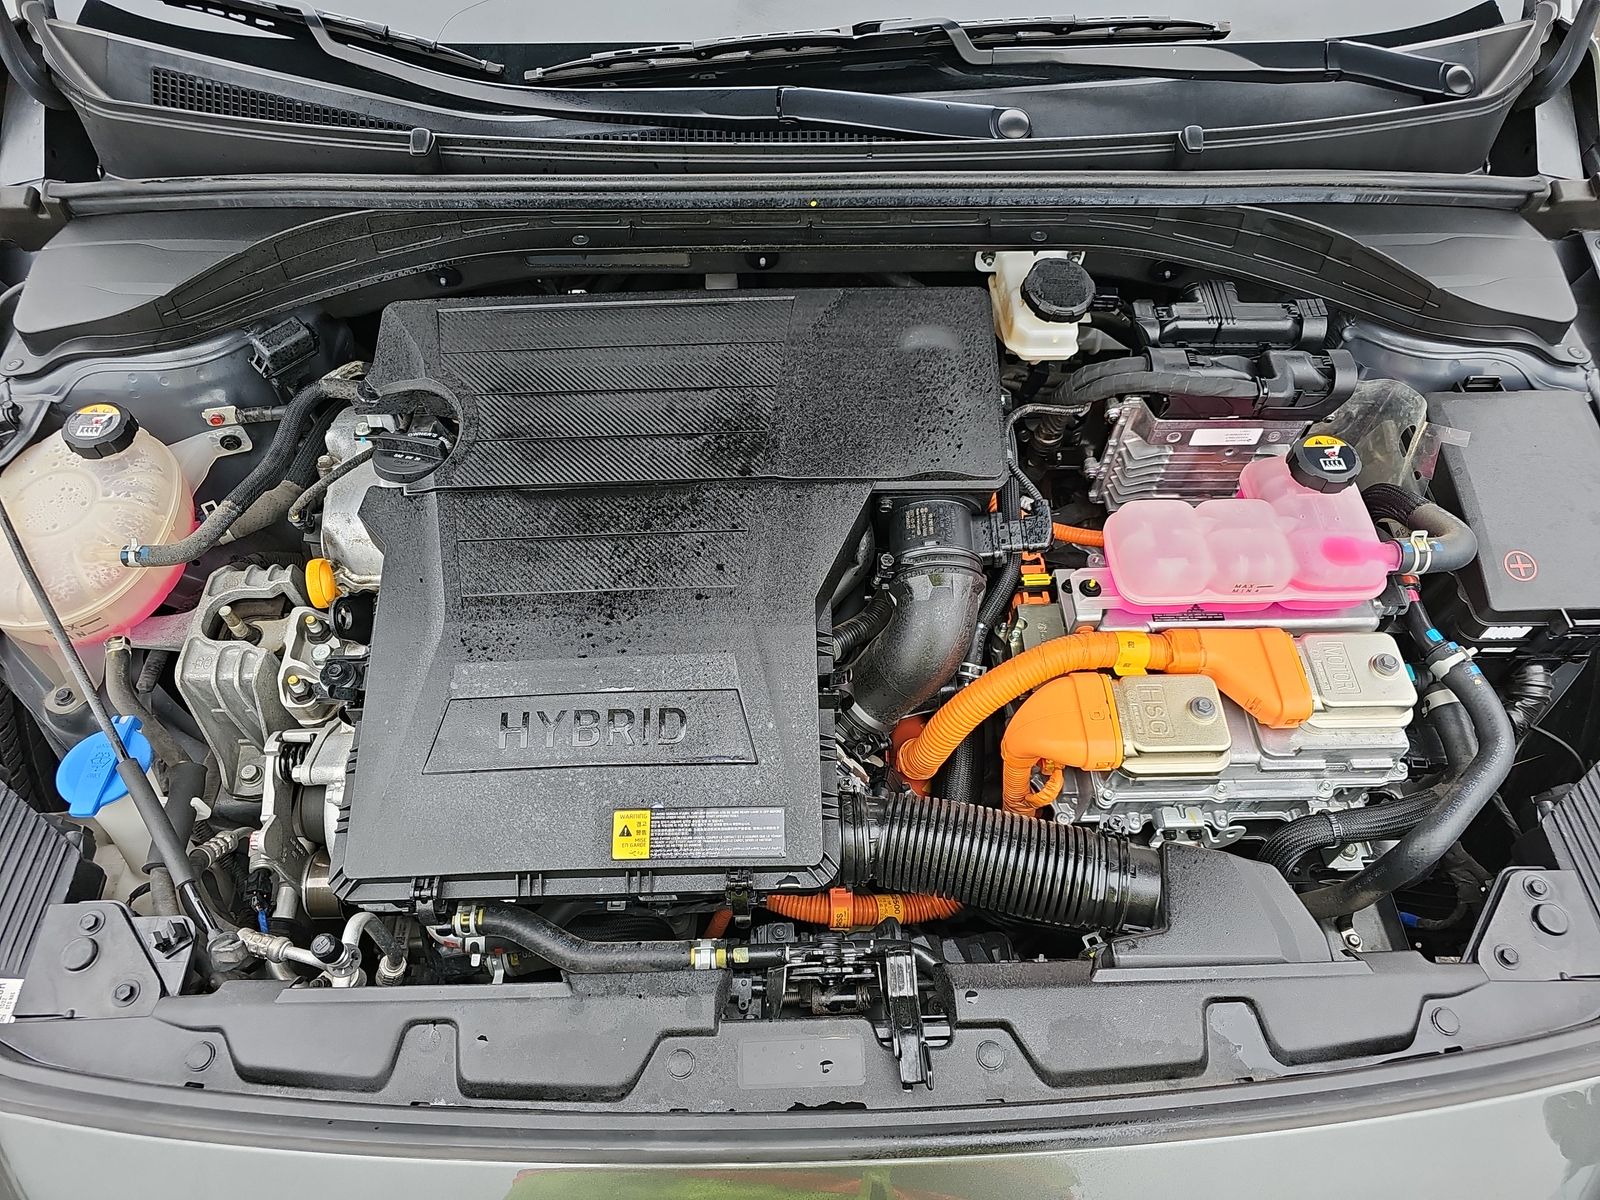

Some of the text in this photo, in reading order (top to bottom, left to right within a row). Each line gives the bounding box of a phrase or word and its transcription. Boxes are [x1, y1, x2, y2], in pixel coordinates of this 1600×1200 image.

[1323, 645, 1356, 691] MOTOR
[498, 706, 688, 750] HYBRID
[1139, 688, 1169, 735] HSG
